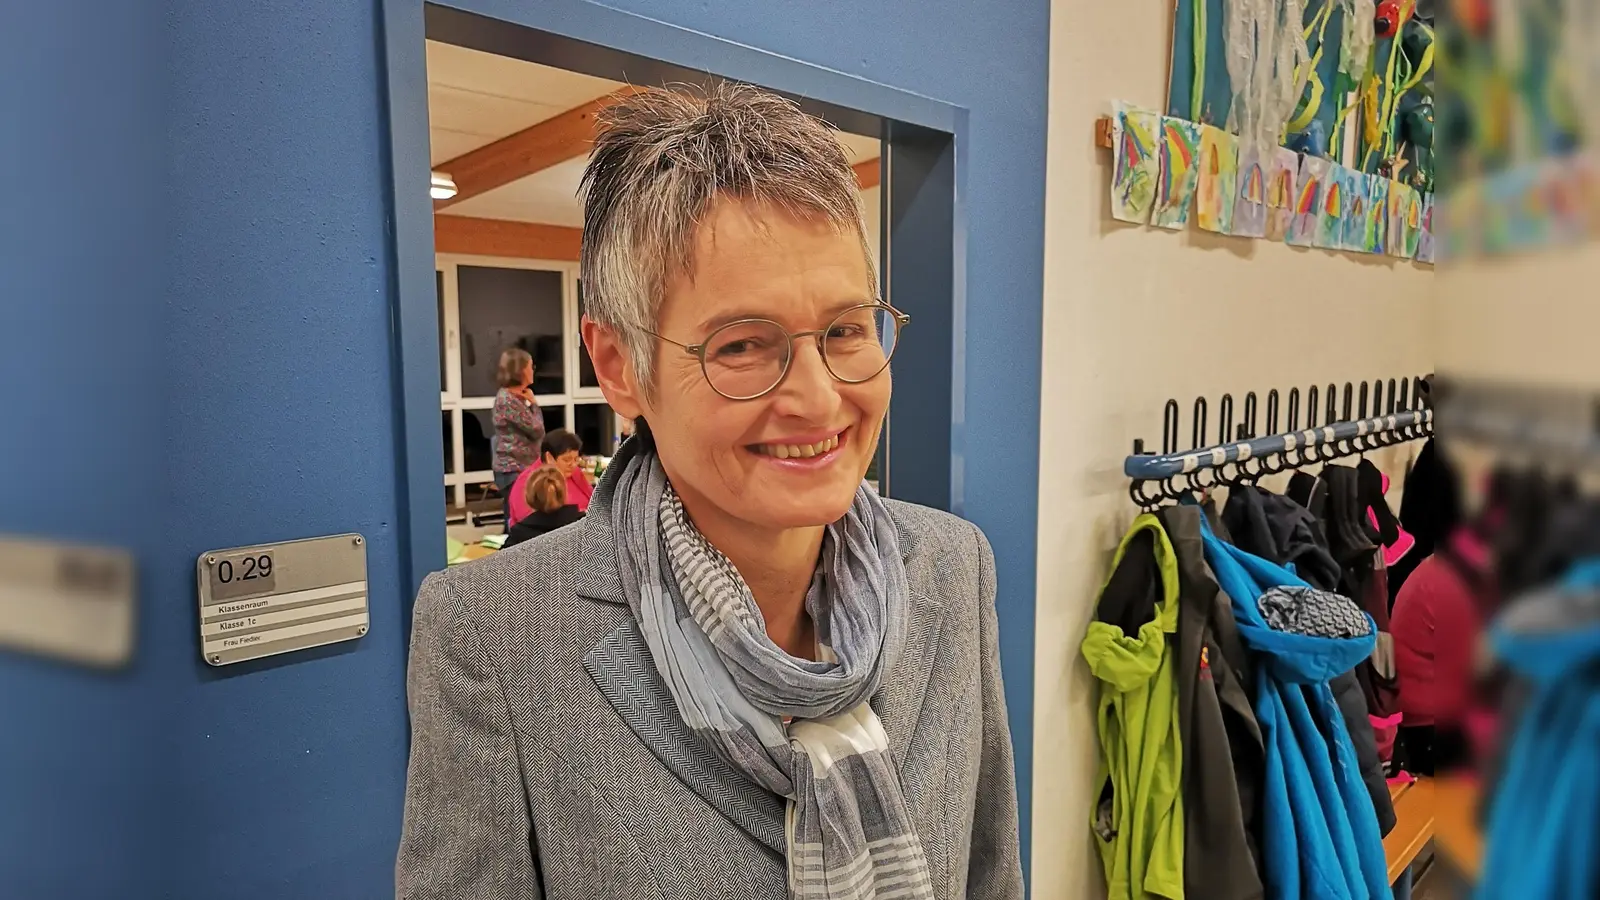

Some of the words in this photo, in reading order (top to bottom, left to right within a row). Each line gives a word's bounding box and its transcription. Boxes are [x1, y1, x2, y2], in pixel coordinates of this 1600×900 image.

[218, 555, 272, 583] 0.29
[218, 600, 268, 613] Klassenraum
[220, 621, 244, 630] Klasse
[248, 618, 257, 626] 1c
[223, 639, 238, 647] Frau
